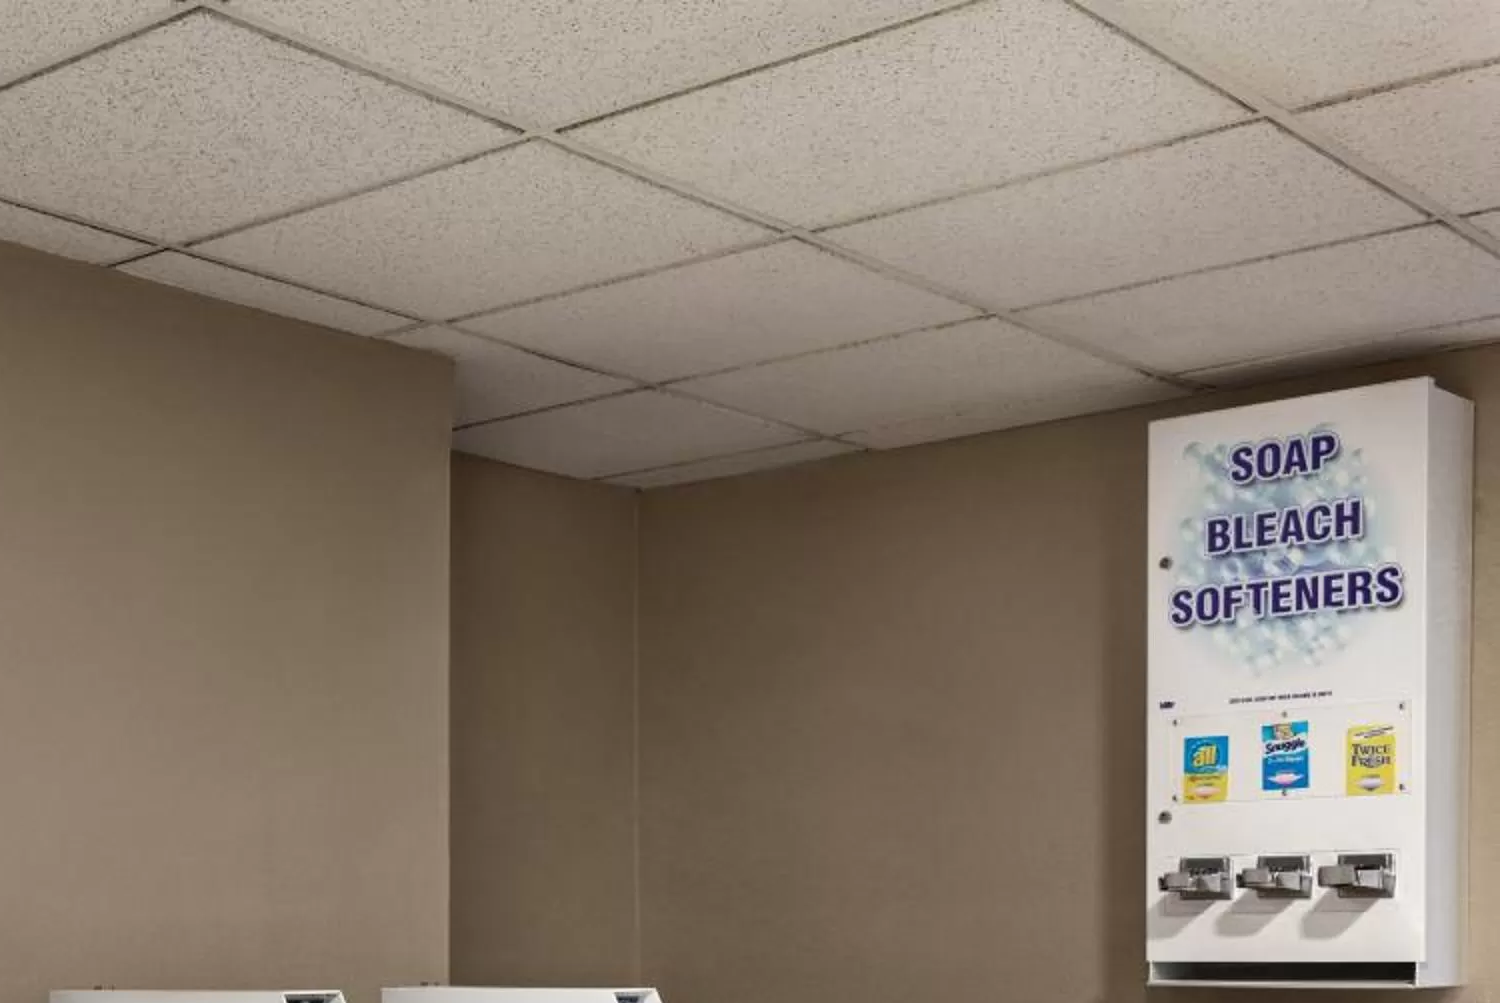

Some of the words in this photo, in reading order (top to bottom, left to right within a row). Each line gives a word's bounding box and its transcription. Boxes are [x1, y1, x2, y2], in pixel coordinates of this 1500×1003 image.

[1230, 433, 1338, 483] SOAP
[1205, 500, 1363, 555] BLEACH
[1170, 565, 1403, 627] SOFTENERS
[1192, 745, 1217, 768] all
[1265, 738, 1306, 754] Snuggle
